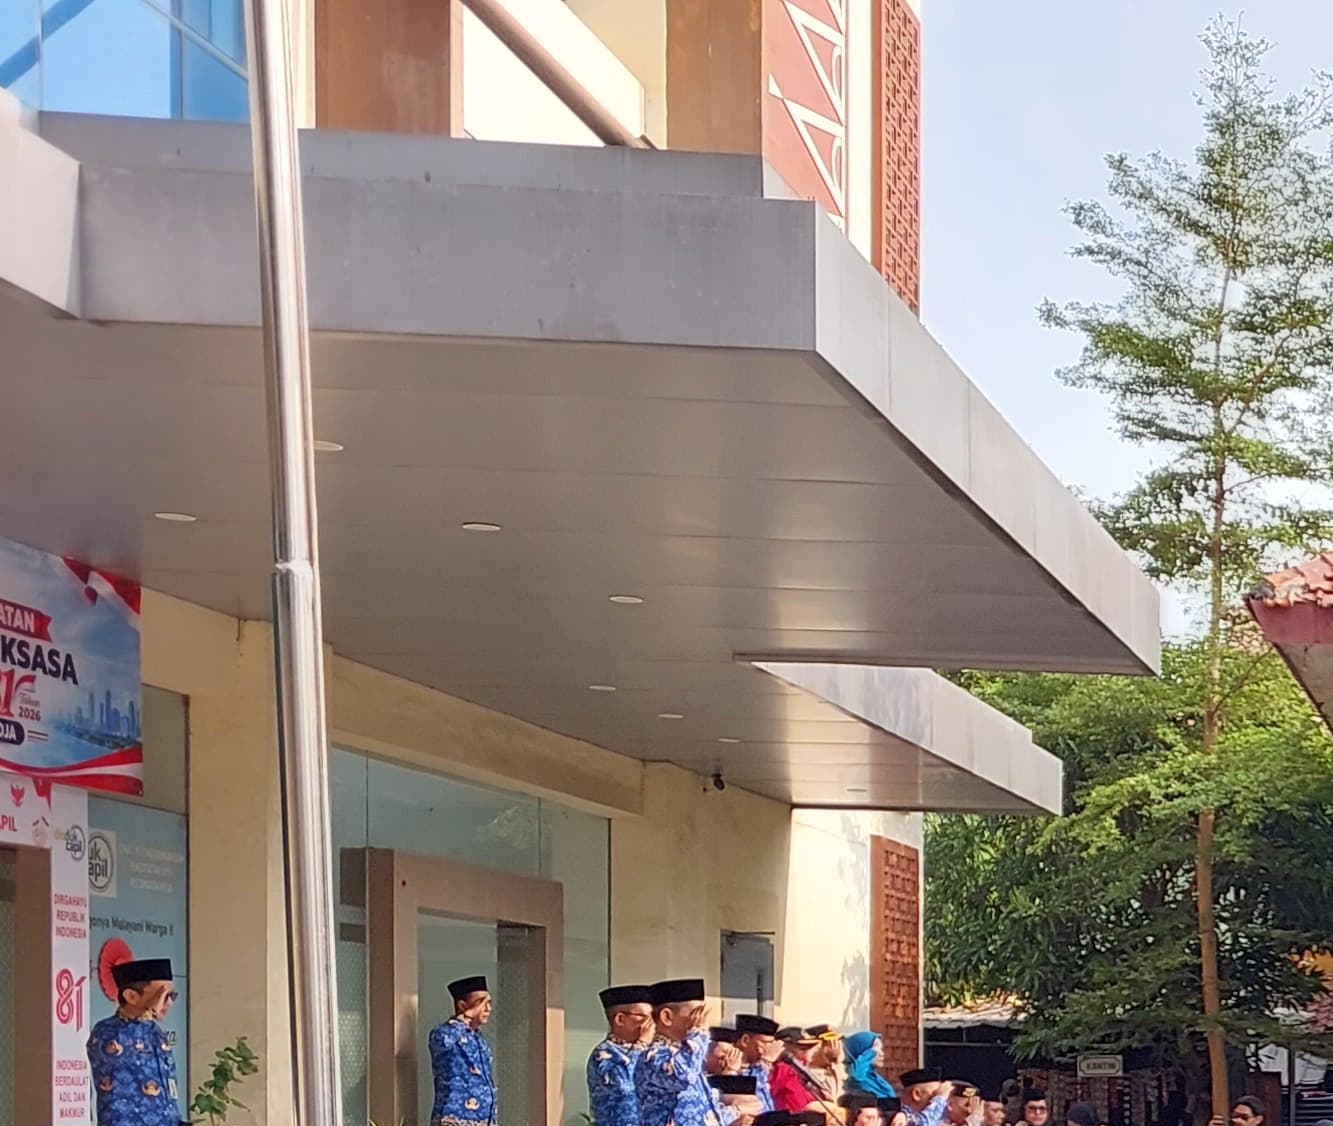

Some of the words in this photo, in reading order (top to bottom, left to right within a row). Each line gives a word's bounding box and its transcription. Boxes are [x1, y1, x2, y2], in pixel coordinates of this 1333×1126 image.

[0, 634, 79, 686] KSASA
[18, 706, 42, 721] 2026
[88, 840, 102, 862] uk
[88, 858, 108, 883] apil
